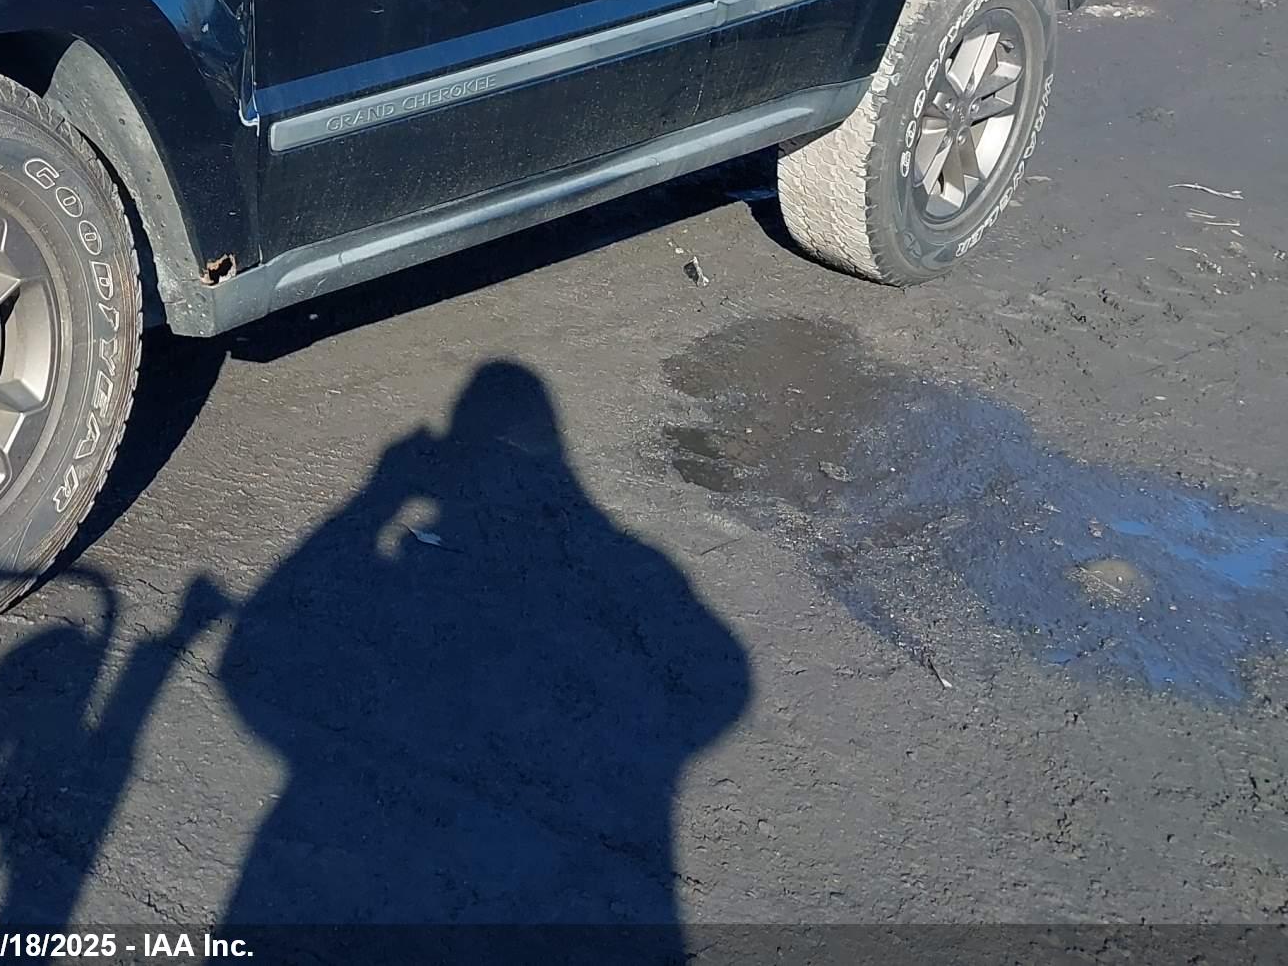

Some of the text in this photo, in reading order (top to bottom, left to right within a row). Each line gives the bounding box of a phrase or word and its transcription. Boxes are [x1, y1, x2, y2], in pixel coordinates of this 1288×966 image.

[325, 74, 498, 131] GRAND CHEROKEE
[23, 158, 118, 512] GOODYEAR
